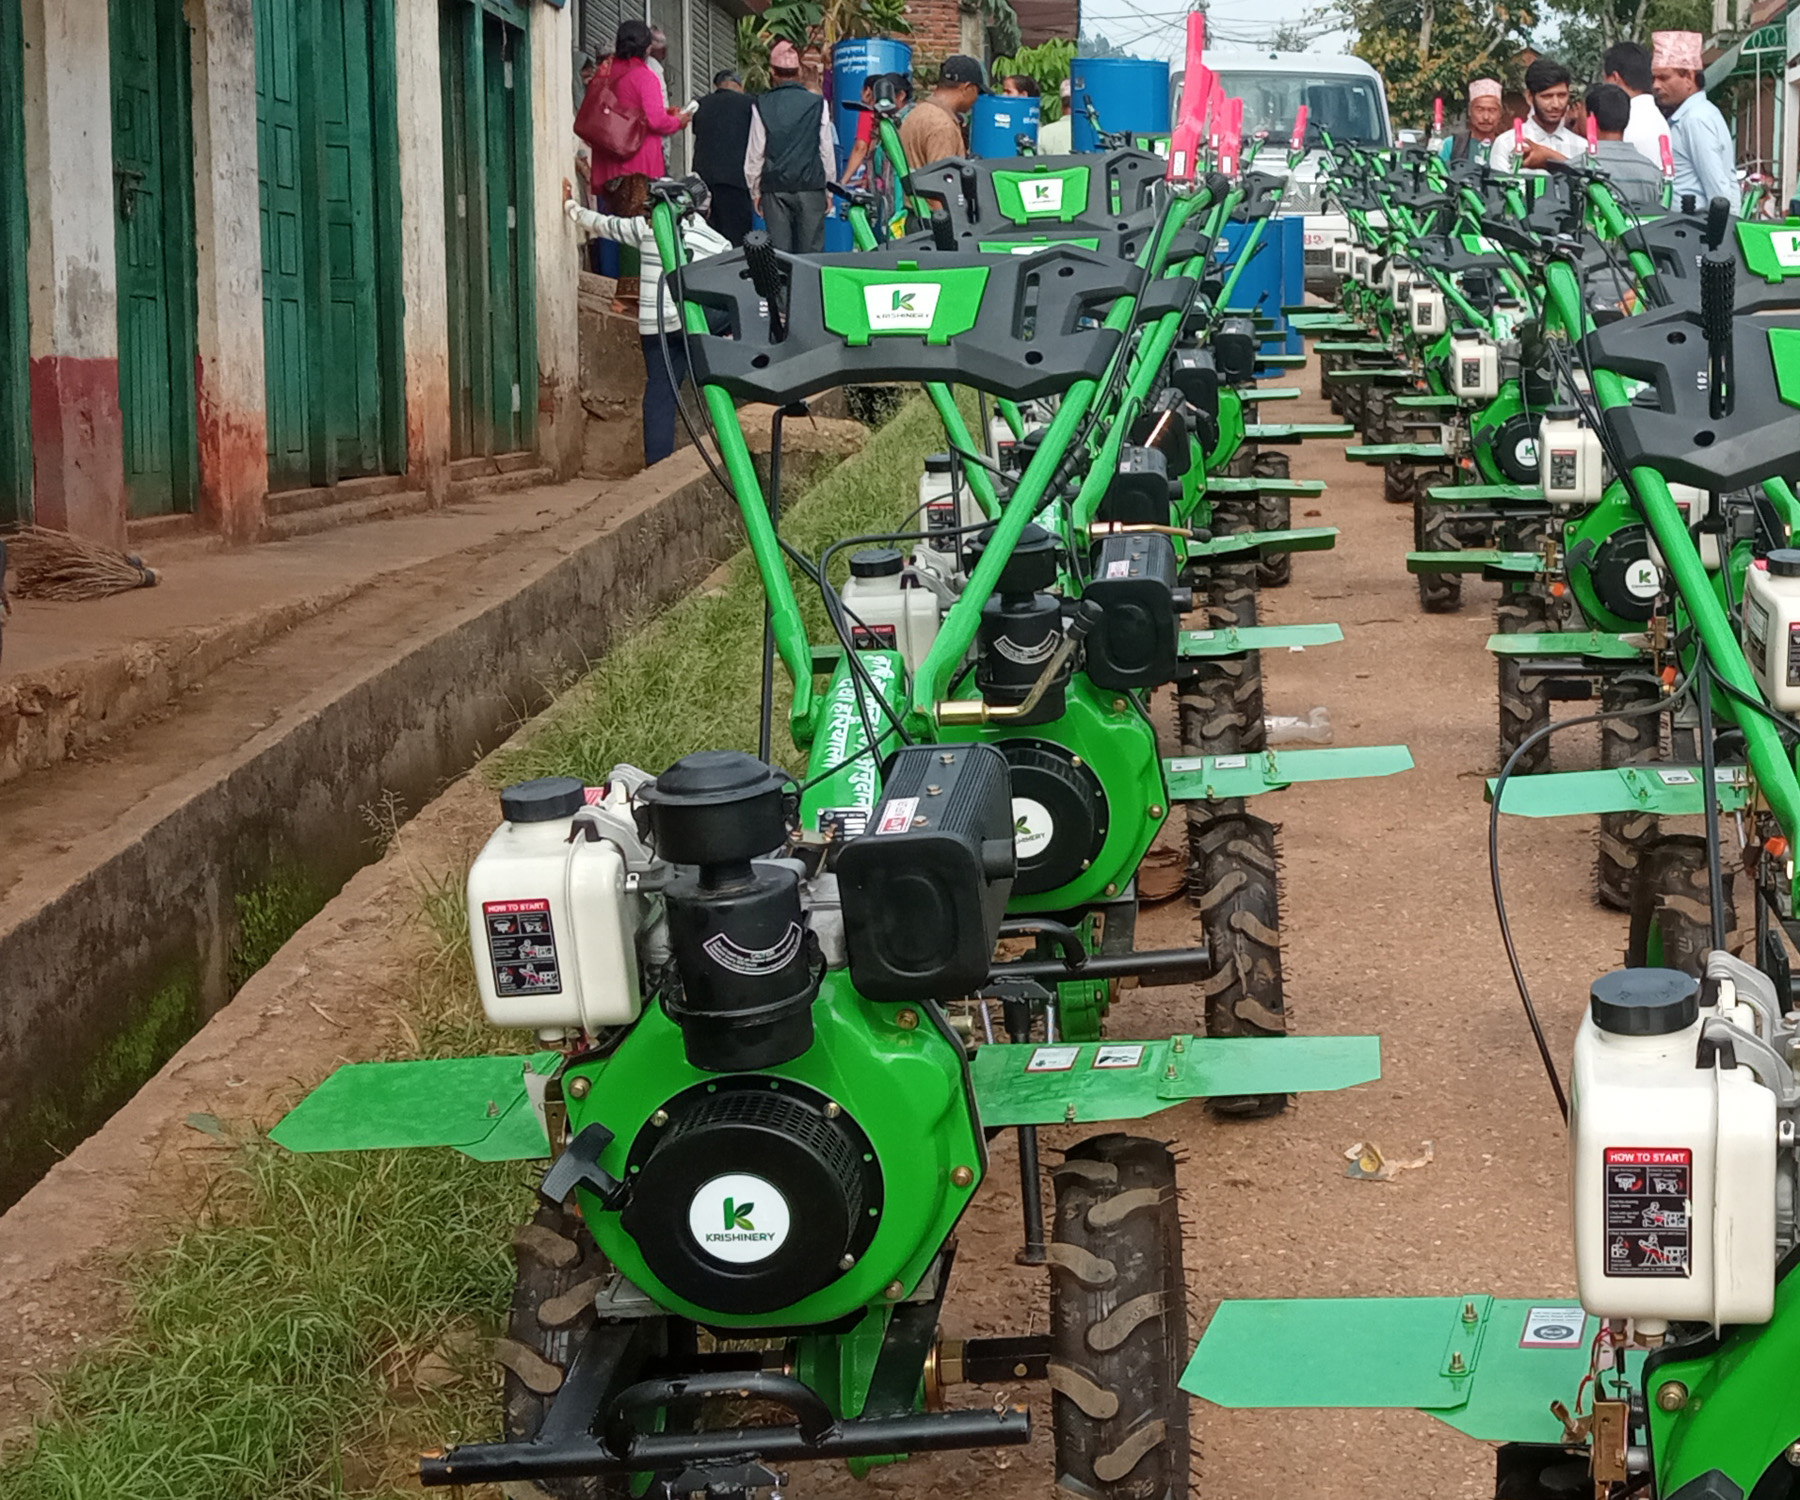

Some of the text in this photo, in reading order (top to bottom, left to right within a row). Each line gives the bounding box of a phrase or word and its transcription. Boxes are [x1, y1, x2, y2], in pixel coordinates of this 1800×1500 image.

[1696, 371, 1708, 390] 102
[1610, 1153, 1685, 1162] HOW TO START
[705, 1232, 776, 1242] KRISHINERY
